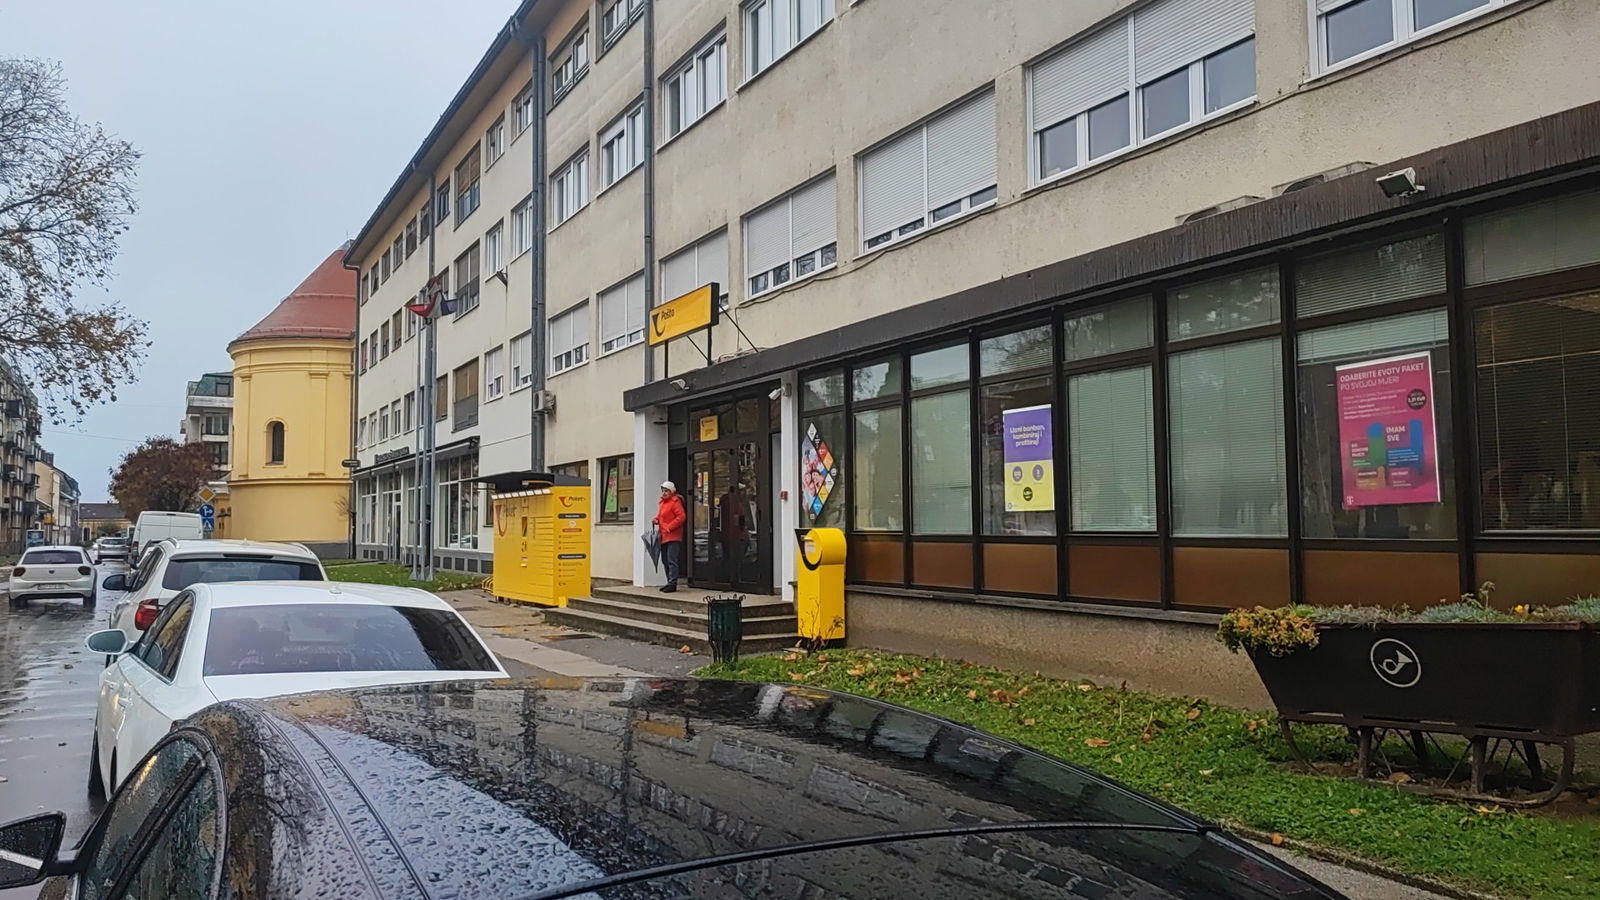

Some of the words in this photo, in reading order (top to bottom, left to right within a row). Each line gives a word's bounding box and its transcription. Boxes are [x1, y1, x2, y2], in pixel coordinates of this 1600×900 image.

[1340, 370, 1378, 383] ODABERITE
[1378, 366, 1400, 377] EVOTV
[1402, 363, 1425, 373] PAKET
[1351, 379, 1377, 390] SVOJOJ
[1386, 425, 1406, 433] IMAM
[1387, 434, 1400, 442] SVE
